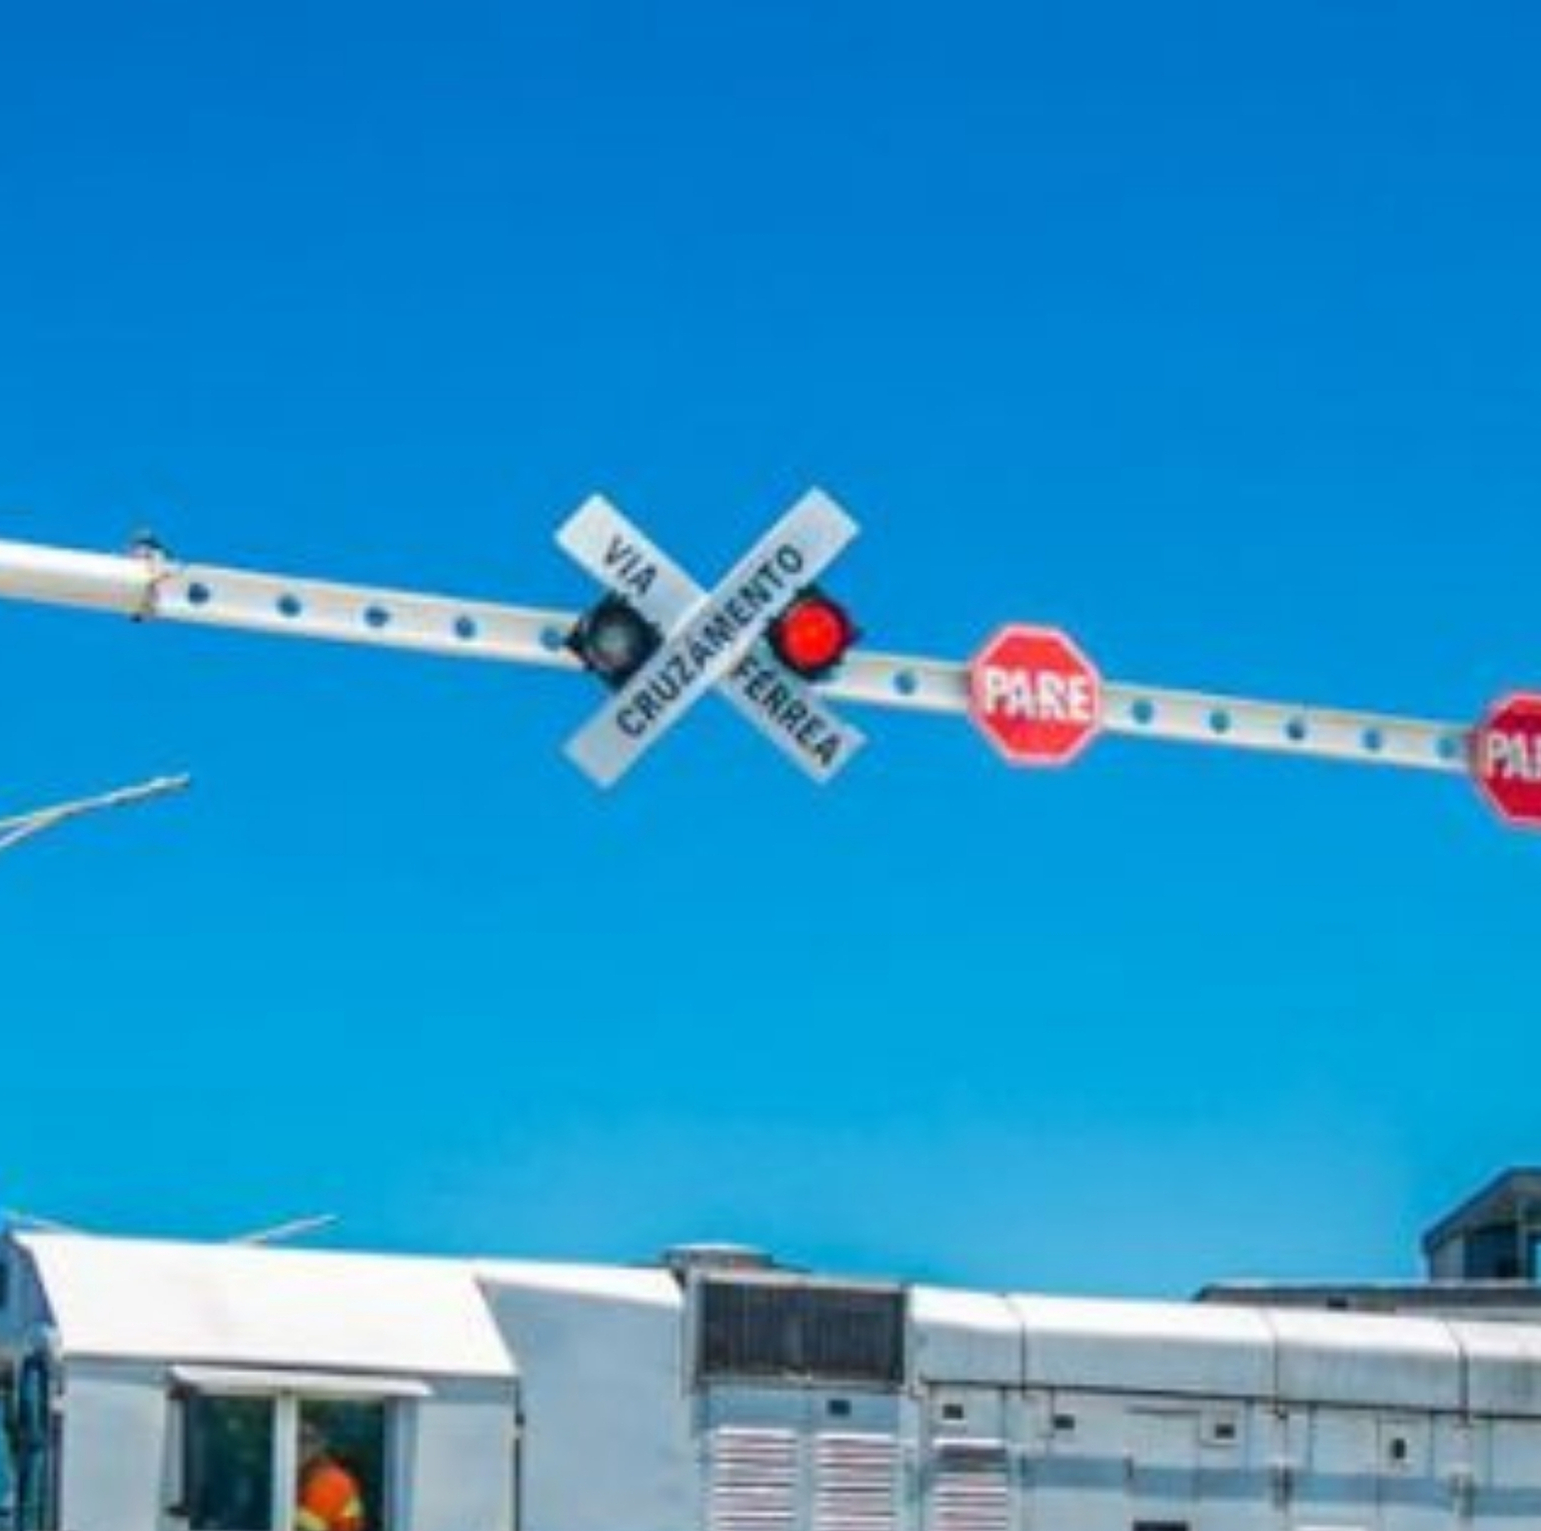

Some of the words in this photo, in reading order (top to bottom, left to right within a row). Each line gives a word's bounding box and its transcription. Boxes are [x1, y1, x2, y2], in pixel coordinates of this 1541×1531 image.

[602, 533, 657, 596] VIA
[615, 543, 804, 740] CRUZAMENTO
[985, 668, 1092, 722] PARE
